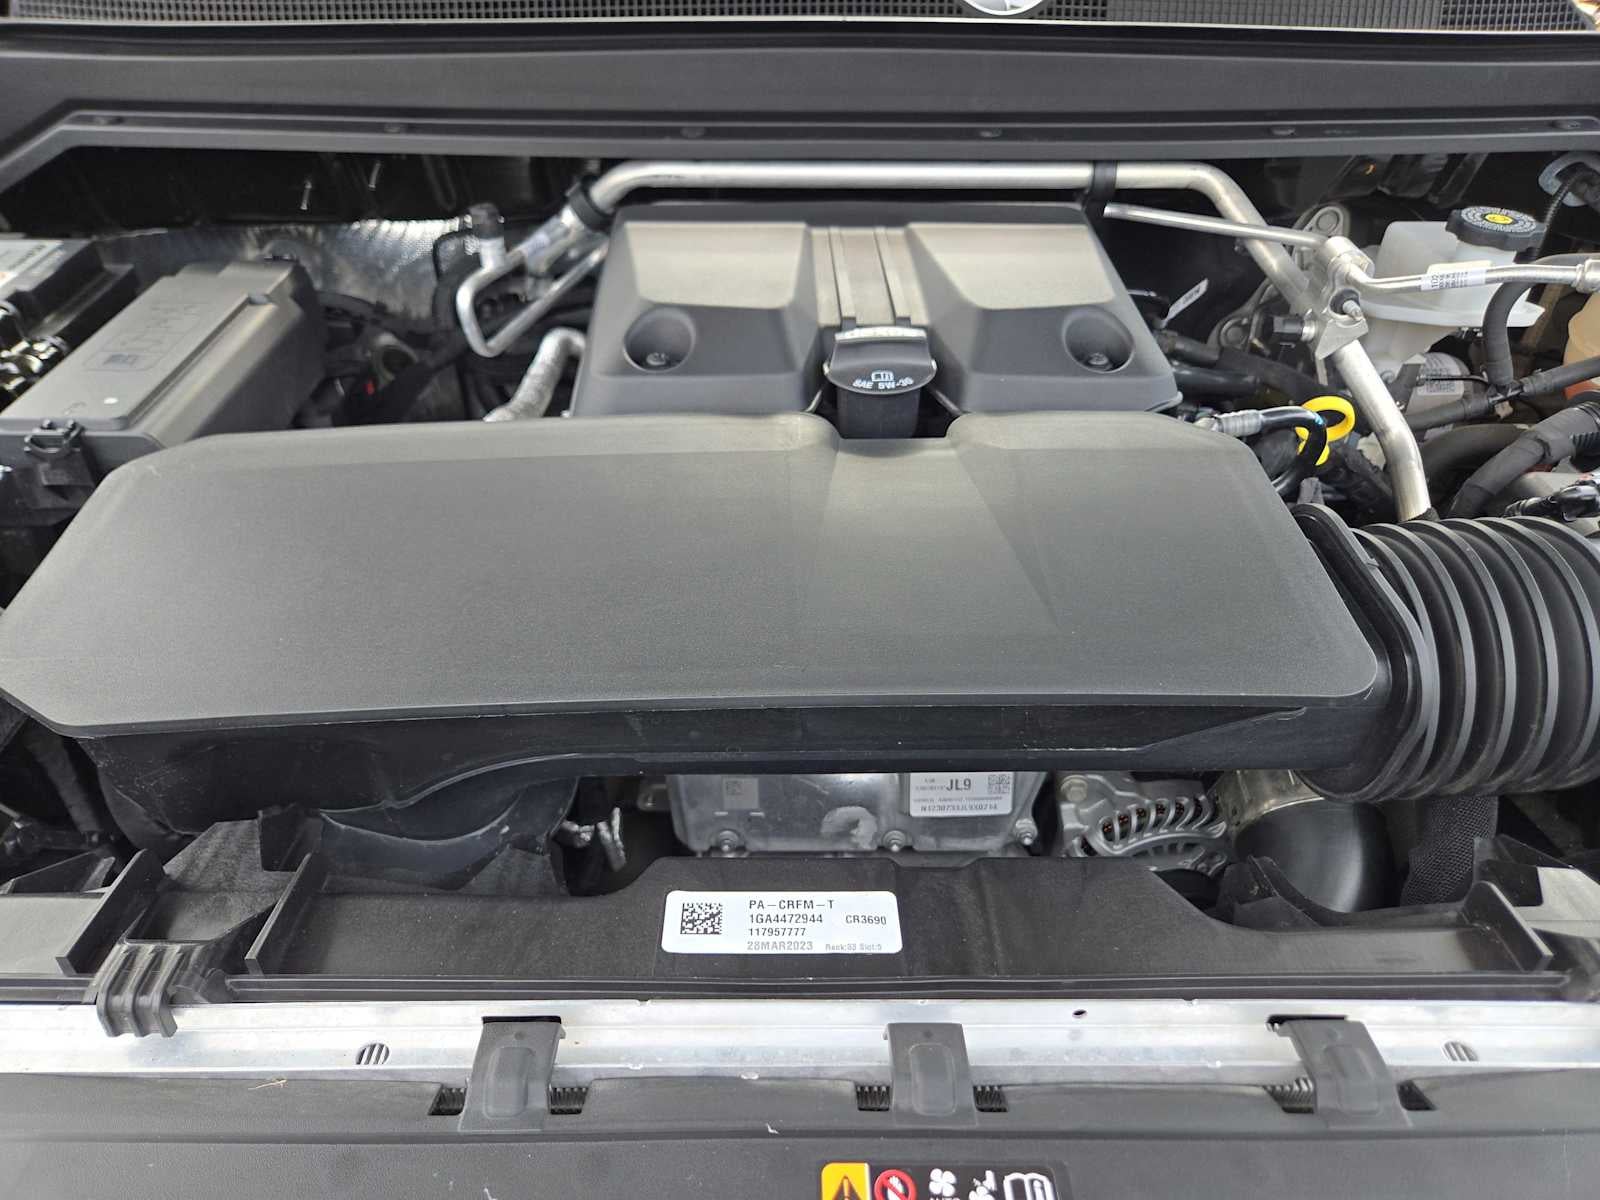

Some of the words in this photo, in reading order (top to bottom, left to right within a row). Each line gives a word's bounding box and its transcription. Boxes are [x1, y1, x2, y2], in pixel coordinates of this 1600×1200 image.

[852, 378, 874, 389] SAE
[877, 376, 914, 389] 5W-30
[945, 778, 972, 791] JL9
[749, 913, 823, 924] 1GA4472944
[845, 914, 887, 925] CR3690
[748, 927, 806, 937] 117957777
[747, 940, 813, 951] 28MAR2023
